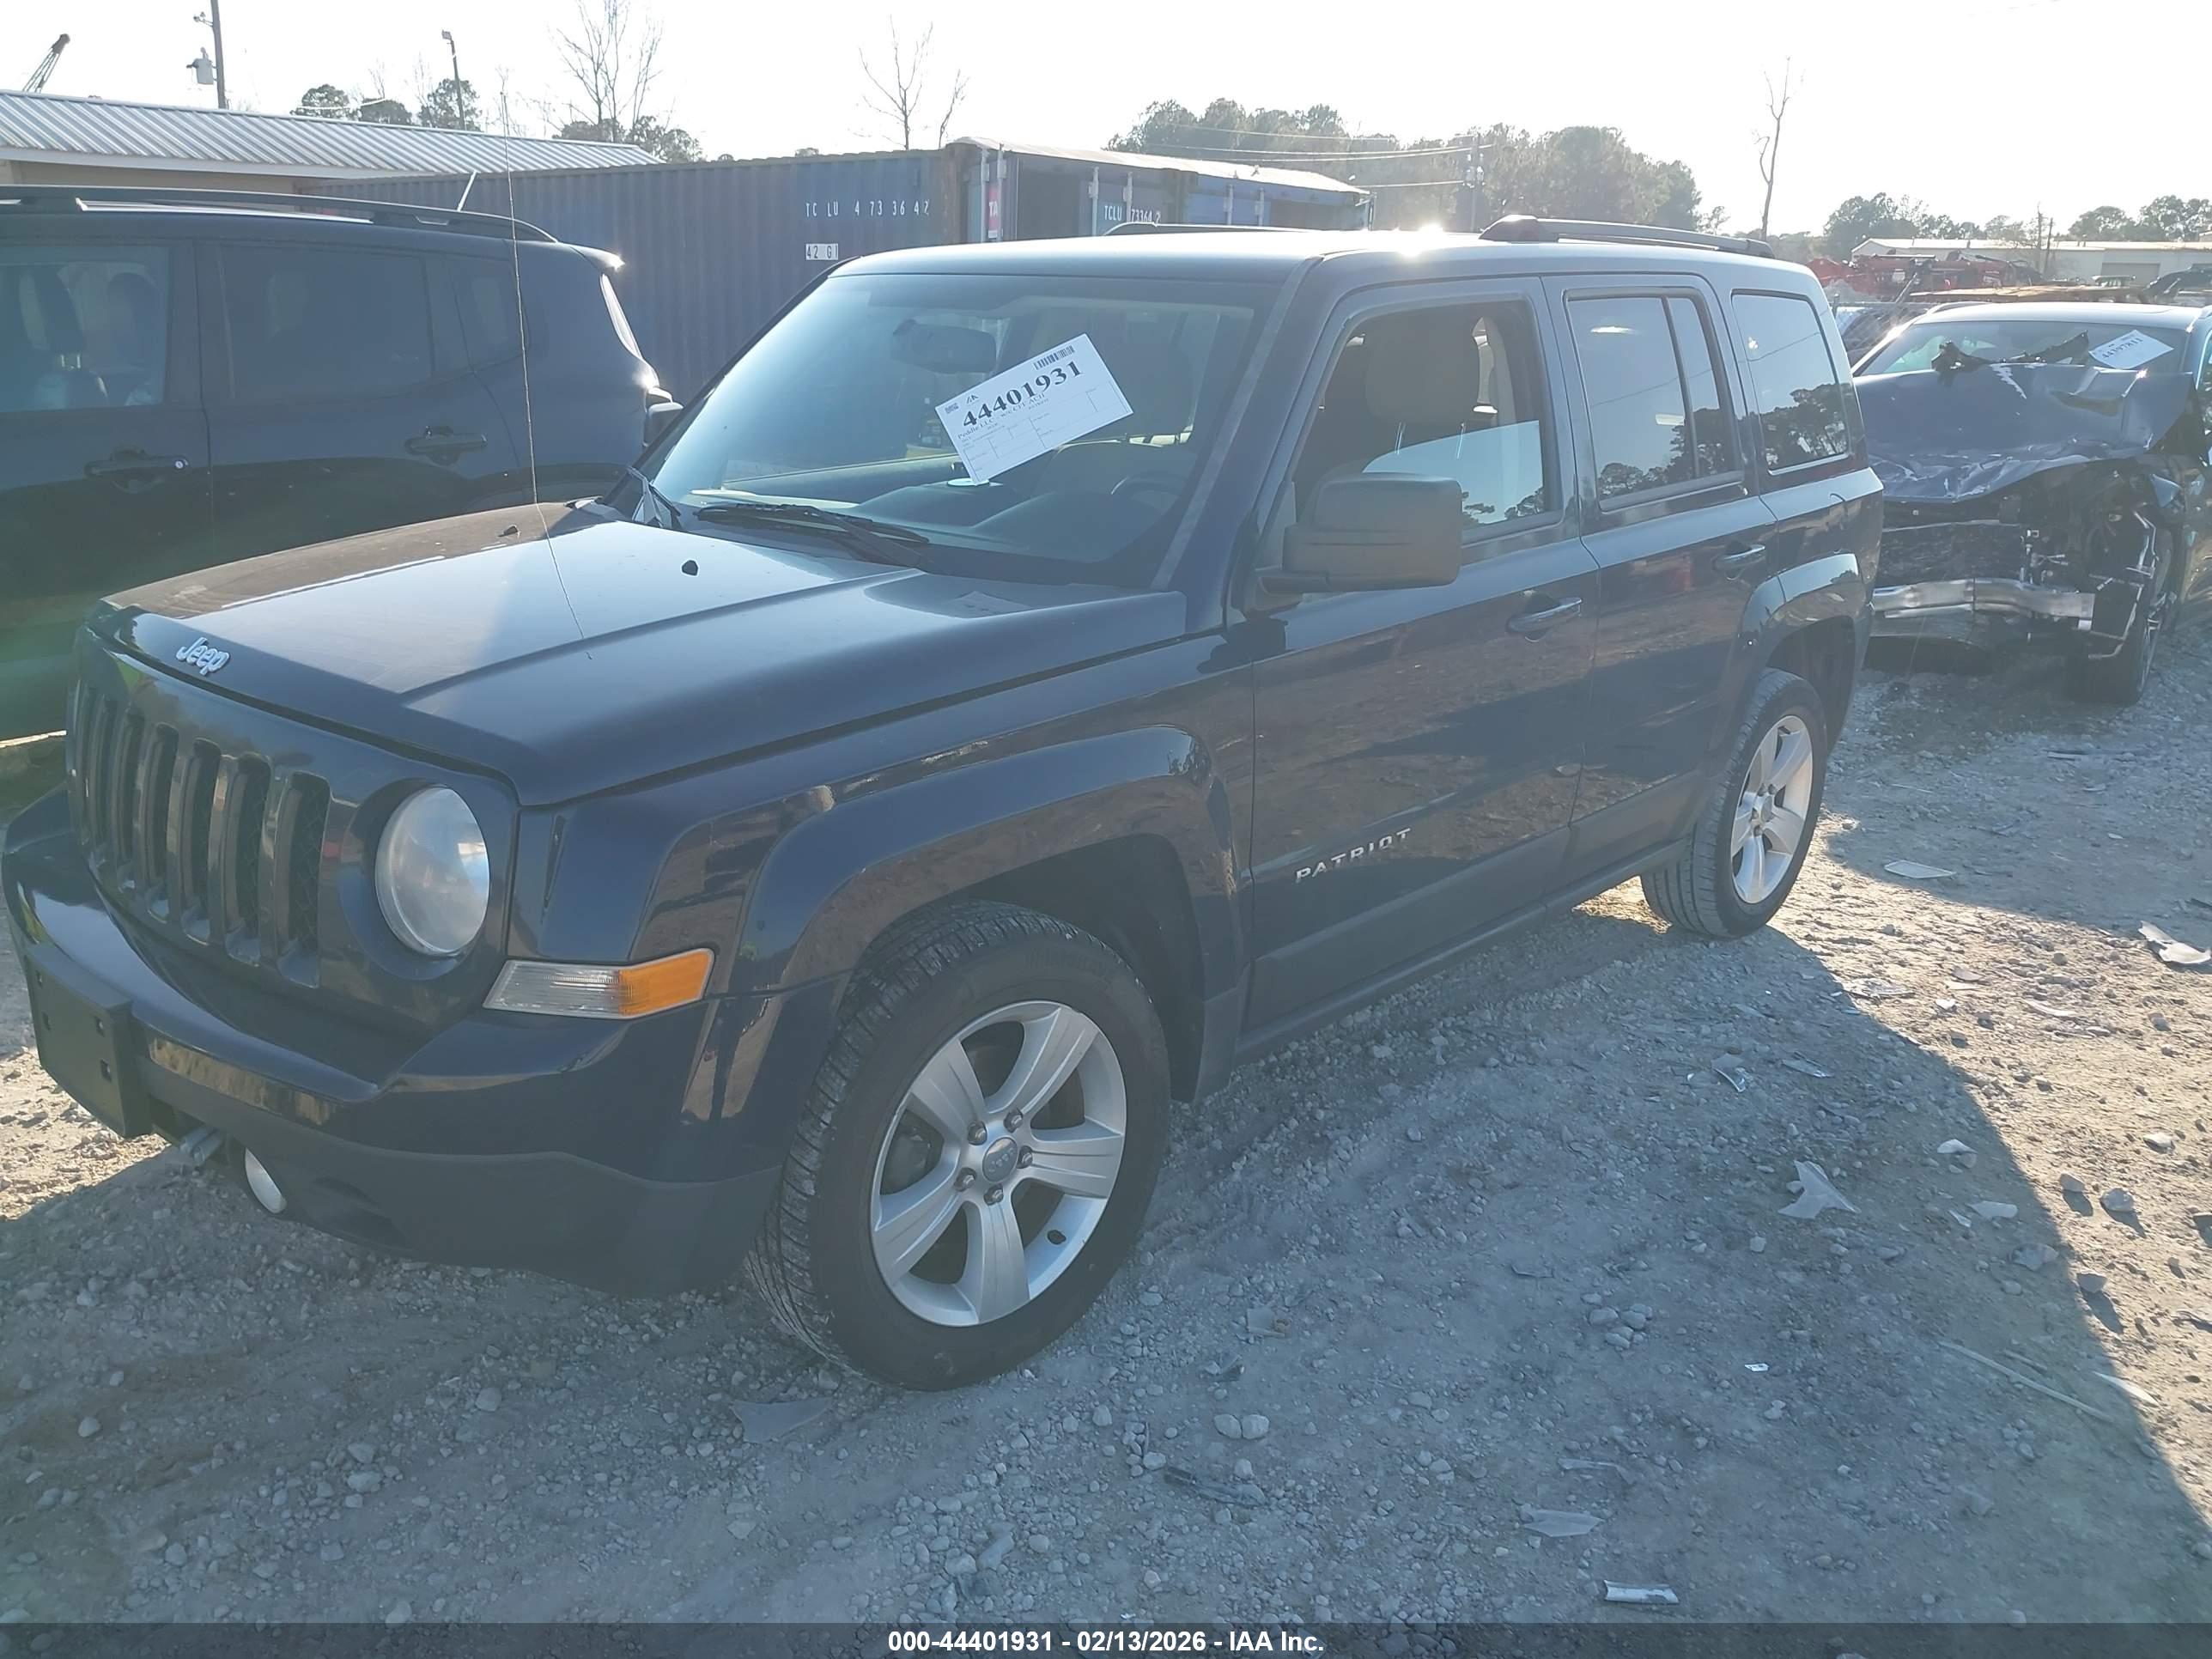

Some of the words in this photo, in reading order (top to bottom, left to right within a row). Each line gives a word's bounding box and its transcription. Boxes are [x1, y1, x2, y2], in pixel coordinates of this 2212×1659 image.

[1104, 205, 1122, 222] TCLU
[963, 361, 1083, 428] 44401931
[175, 636, 230, 676] Jeep
[1295, 828, 1411, 884] PATRIOT
